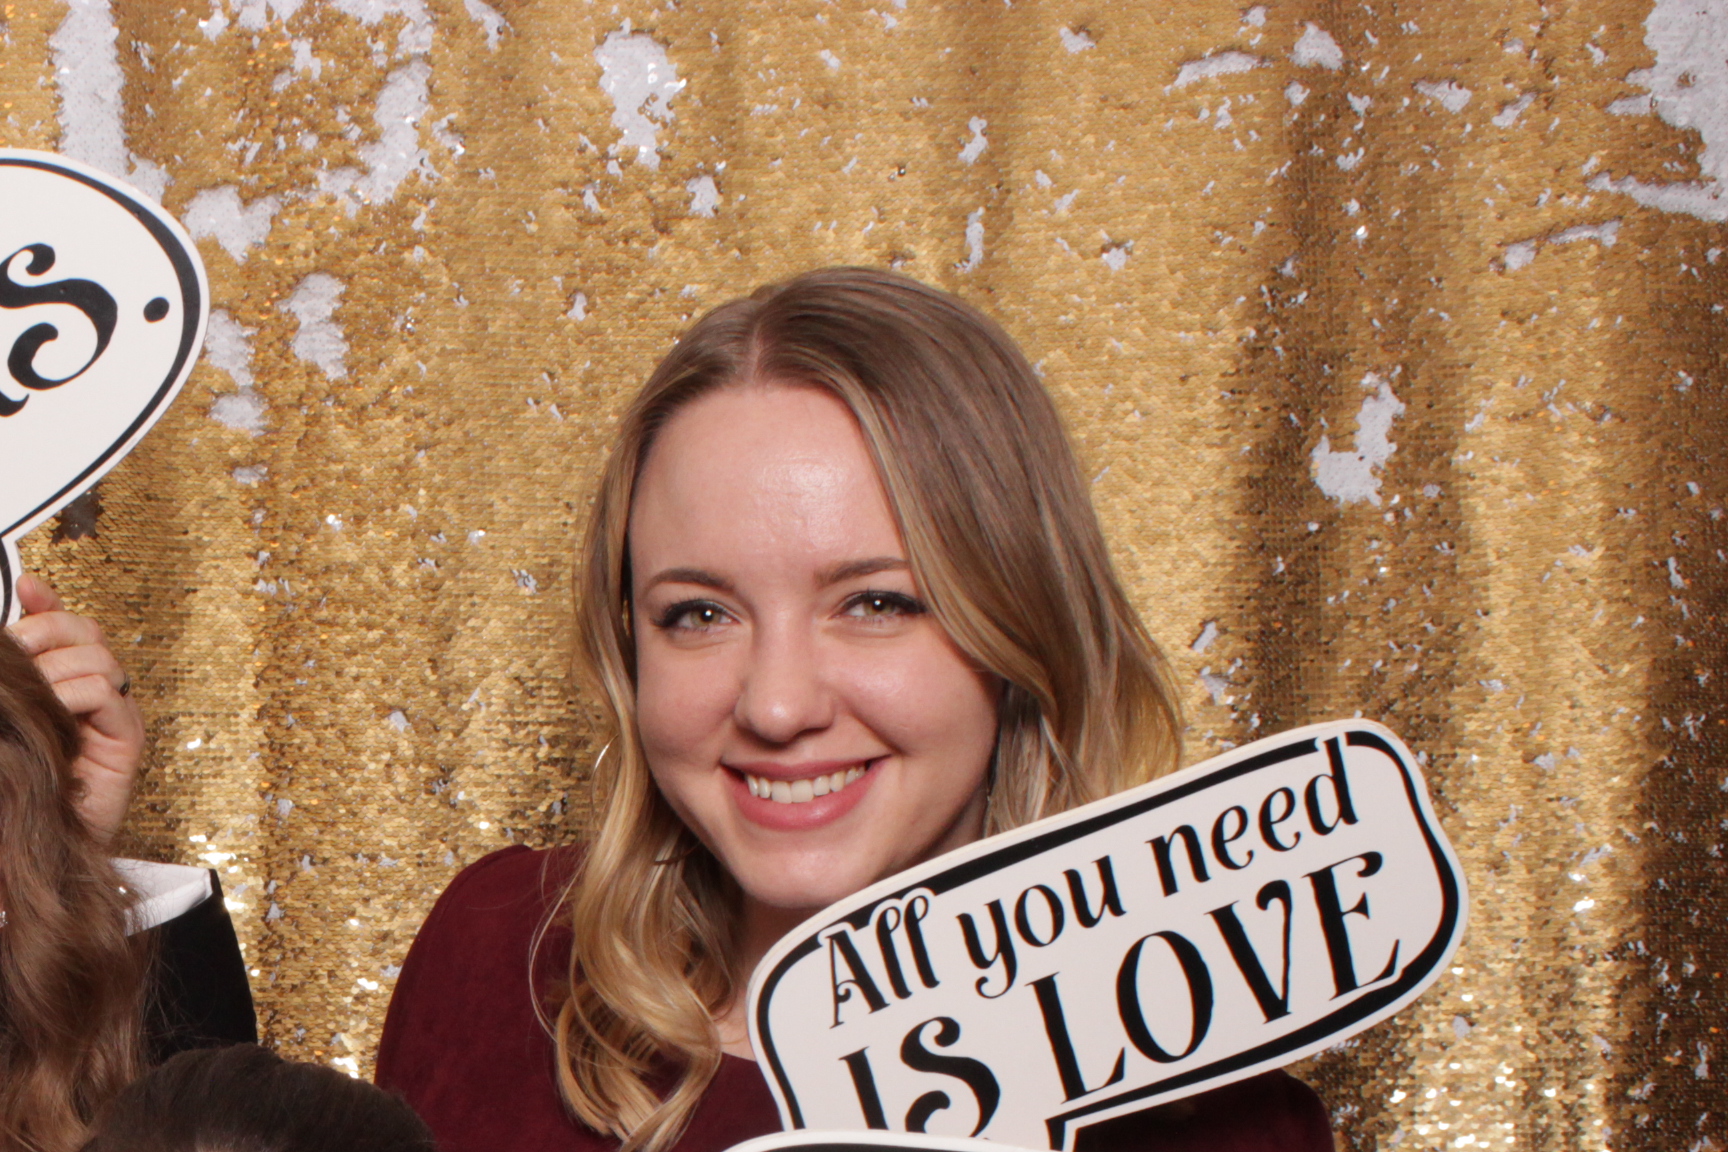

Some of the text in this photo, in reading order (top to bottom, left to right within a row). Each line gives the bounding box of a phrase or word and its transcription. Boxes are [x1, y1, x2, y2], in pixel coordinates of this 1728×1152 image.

[828, 736, 1360, 1031] All you need
[838, 850, 1402, 1140] IS LOVE
